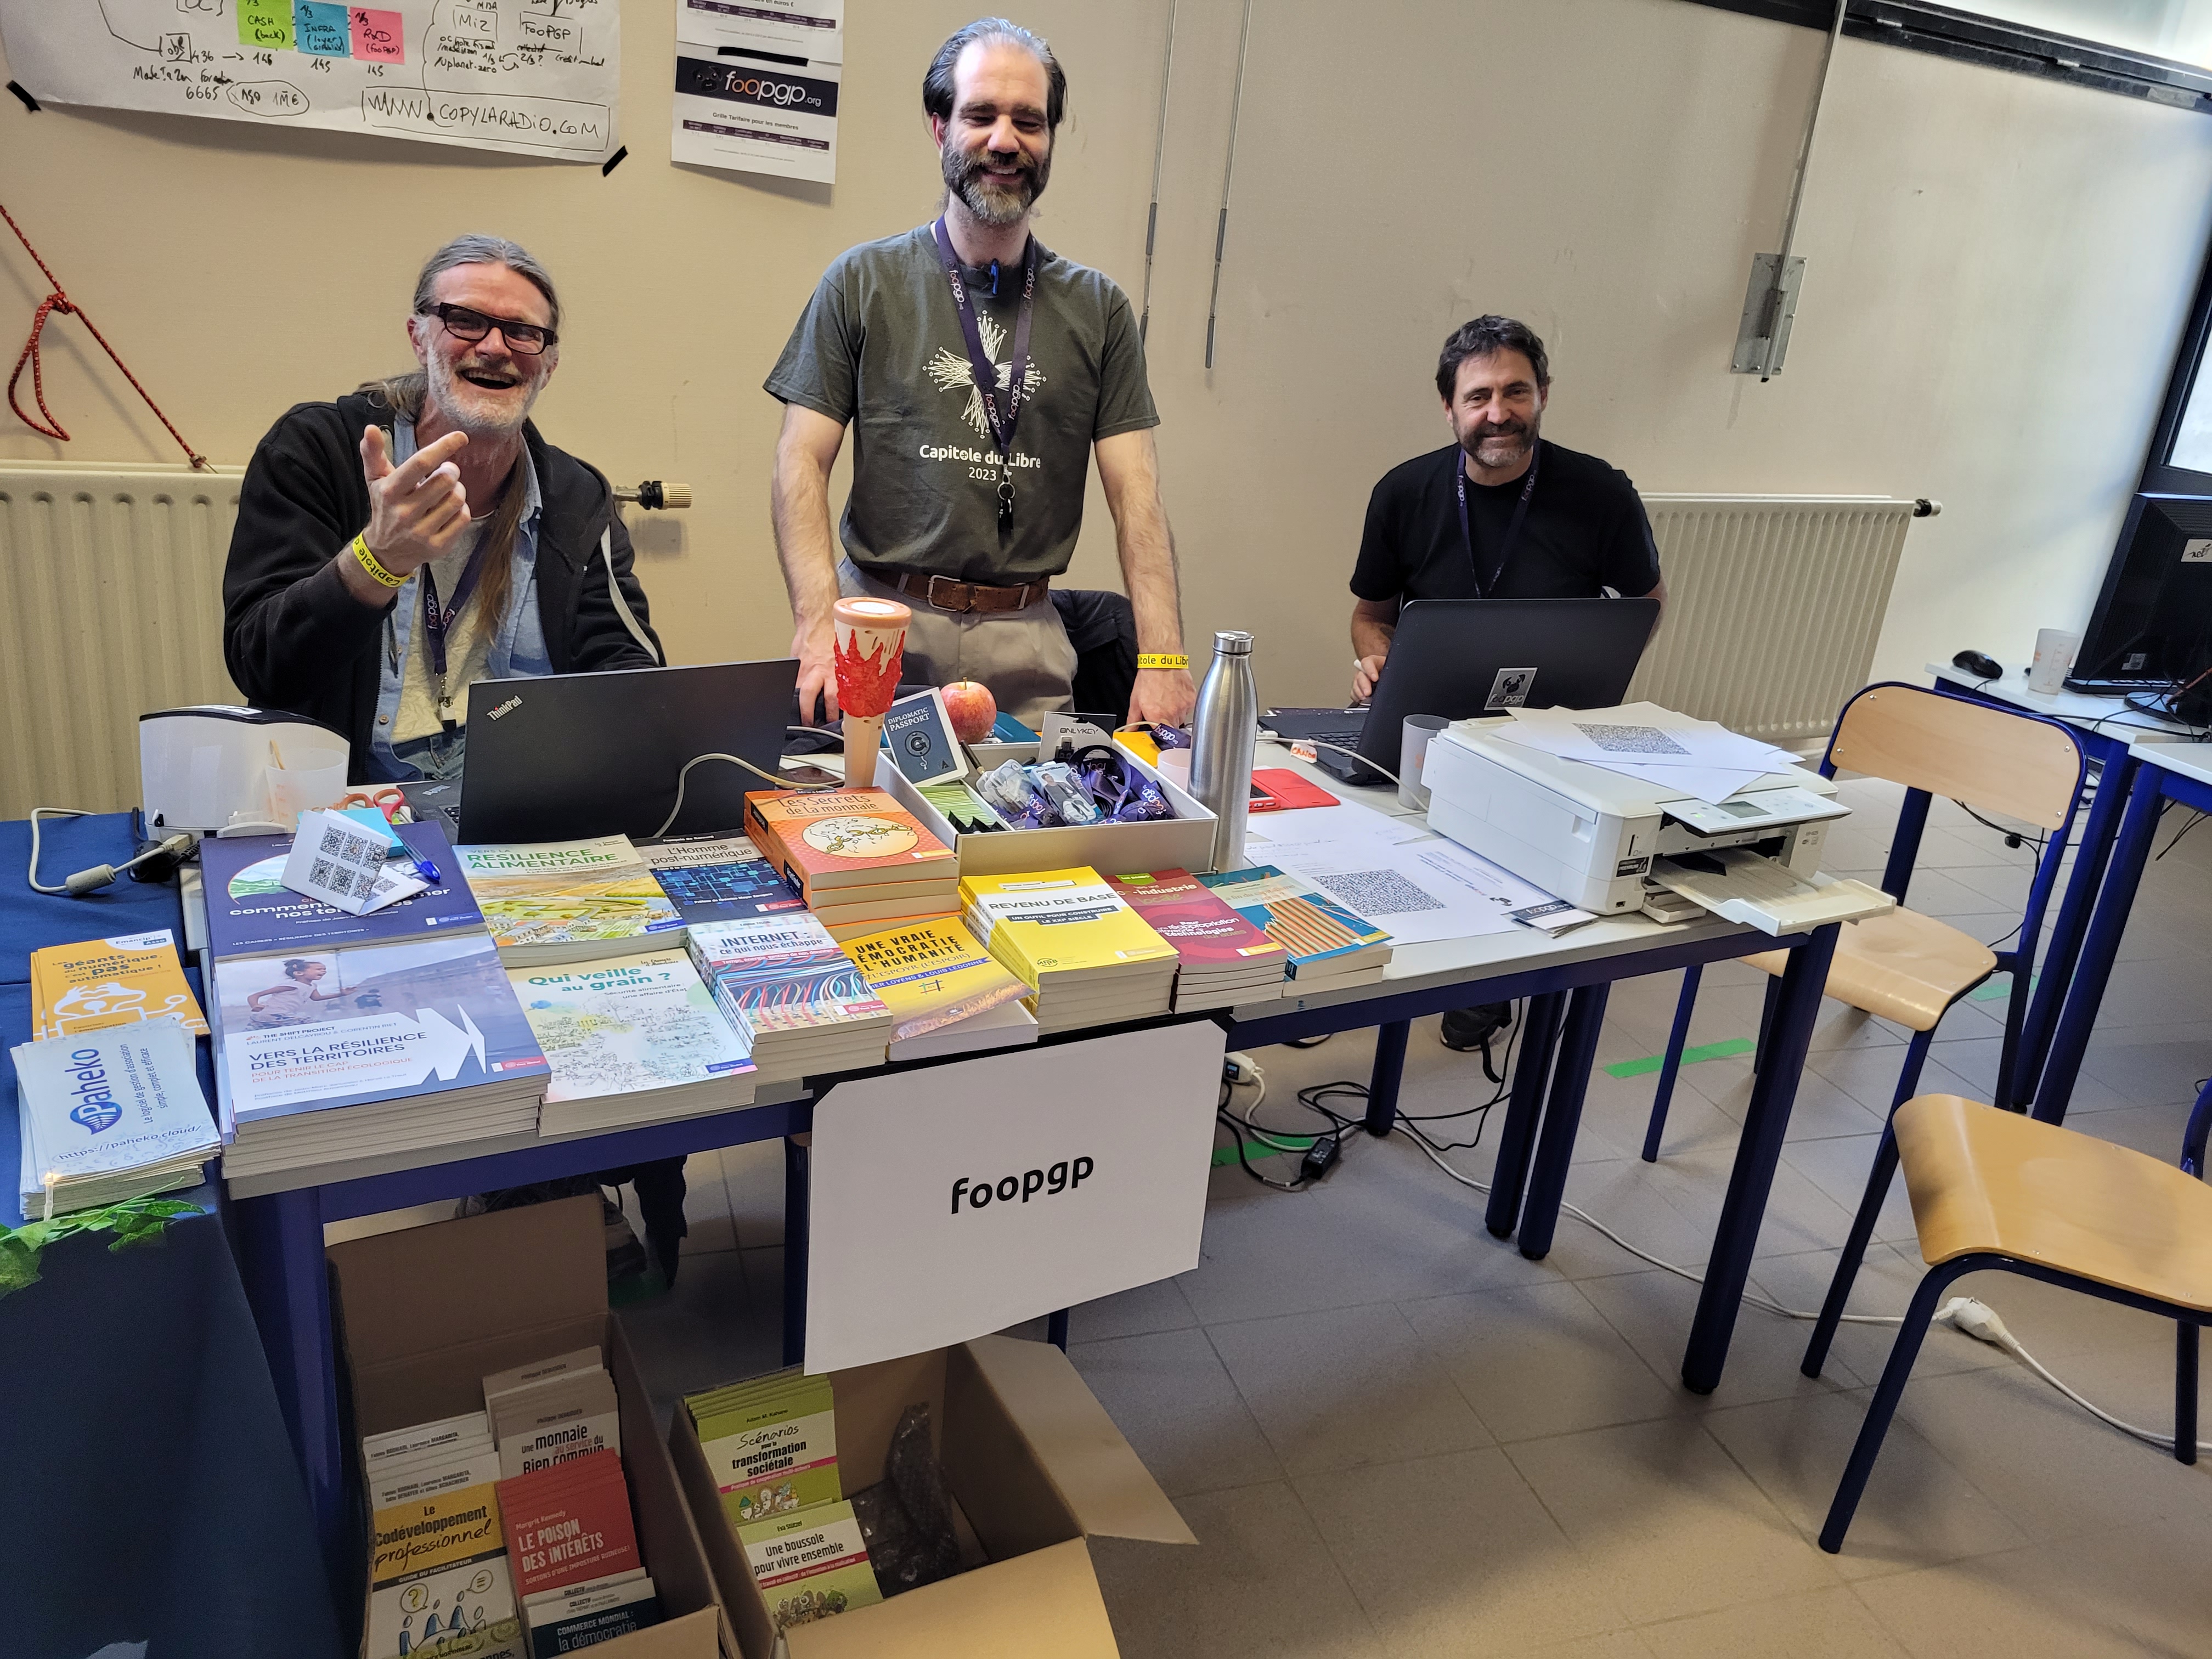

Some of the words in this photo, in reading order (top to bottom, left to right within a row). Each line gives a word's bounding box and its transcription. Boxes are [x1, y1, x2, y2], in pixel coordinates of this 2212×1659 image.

[247, 15, 274, 25] CASH
[304, 24, 336, 32] INFRA
[255, 29, 285, 43] (back)
[186, 85, 220, 101] 6665
[724, 71, 822, 106] foopgp.org
[729, 114, 750, 123] Tarifaire
[775, 122, 799, 130] membres
[919, 444, 982, 462] Capitole
[985, 450, 1003, 465] du
[968, 467, 997, 481] 2023
[359, 548, 400, 586] Capitole
[1161, 656, 1172, 664] du
[1489, 693, 1524, 704] foopgp
[487, 695, 524, 721] ThinkPad
[888, 707, 928, 724] DIPLOMATIC
[890, 713, 929, 731] PASSPORT
[777, 799, 806, 808] Les
[807, 795, 870, 805] Secrets
[820, 803, 878, 814] monnaie
[651, 848, 753, 865] post-numérique
[667, 844, 729, 855] L'Homme
[471, 853, 618, 868] ALIMENTAIRE
[989, 900, 1051, 910] REVENU
[1076, 893, 1118, 902] BASE
[1136, 893, 1183, 905] locale
[275, 910, 312, 919] nos
[1067, 907, 1113, 916] CONSTRUIRE
[1165, 927, 1234, 936] technologies
[1168, 918, 1240, 929] réappropriation
[721, 931, 800, 947] INTERNET
[782, 939, 823, 947] échappe
[855, 941, 886, 953] UNE
[890, 930, 935, 945] VRAIE
[64, 955, 125, 969] géants
[865, 943, 965, 972] L'HUMANITÉ
[921, 953, 970, 969] (L'ESPOIR)
[69, 966, 153, 983] automatique
[92, 964, 129, 975] pas
[528, 974, 571, 986] Qui
[577, 968, 642, 980] veille
[886, 975, 916, 986] LOYENS
[924, 968, 947, 977] LOUIS
[949, 960, 984, 971] LEDONNE
[590, 975, 652, 991] grain
[247, 1037, 282, 1045] LAURENT
[284, 1031, 331, 1040] DELCAYROU
[249, 1049, 297, 1061] VERS
[302, 1046, 324, 1054] LA
[329, 1032, 427, 1051] RÉSILIENCE
[120, 1044, 136, 1073] d'association
[140, 1048, 153, 1065] efficace
[251, 1059, 287, 1070] DES
[291, 1044, 405, 1065] TERRITOIRES
[285, 1067, 345, 1079] TRANSITION
[347, 1058, 413, 1070] ÉCOLOGIQUE
[64, 1048, 117, 1120] Paheko
[130, 1074, 145, 1091] gestion
[149, 1073, 162, 1091] complet
[134, 1091, 144, 1099] de
[156, 1091, 168, 1109] simple,
[136, 1100, 153, 1116] logiciel
[59, 1125, 202, 1160] https://paheko.cloud/
[951, 1155, 1094, 1215] foopgp
[522, 1444, 534, 1454] Une
[535, 1425, 588, 1450] monnaie
[566, 1438, 592, 1452] service
[594, 1435, 603, 1444] du
[737, 1425, 799, 1450] Scénarios
[732, 1441, 806, 1469] transformation
[523, 1458, 549, 1475] Bien
[747, 1457, 793, 1477] sociétale
[424, 1506, 436, 1516] Le
[375, 1505, 487, 1547] Codéveloppement
[516, 1519, 540, 1531] Margrit
[540, 1510, 566, 1522] Kennedy
[375, 1518, 492, 1572] professionnel
[518, 1533, 535, 1552] LE
[765, 1544, 784, 1557] Une
[784, 1533, 825, 1552] boussole
[522, 1551, 546, 1573] DES
[754, 1561, 775, 1577] pour
[776, 1556, 800, 1568] vivre
[801, 1542, 844, 1562] ensemble
[399, 1573, 418, 1583] GUIDE
[420, 1570, 428, 1578] DU
[430, 1559, 472, 1575] FACILITATEUR
[525, 1572, 551, 1585] SORTONS
[552, 1567, 568, 1576] D'UNE
[568, 1555, 600, 1569] IMPOSTURE
[569, 1598, 591, 1607] COLLECTIF
[557, 1620, 597, 1637] COMMERCE
[599, 1611, 629, 1625] MONDIAL
[558, 1637, 569, 1652] la
[572, 1621, 637, 1649] démocratie
